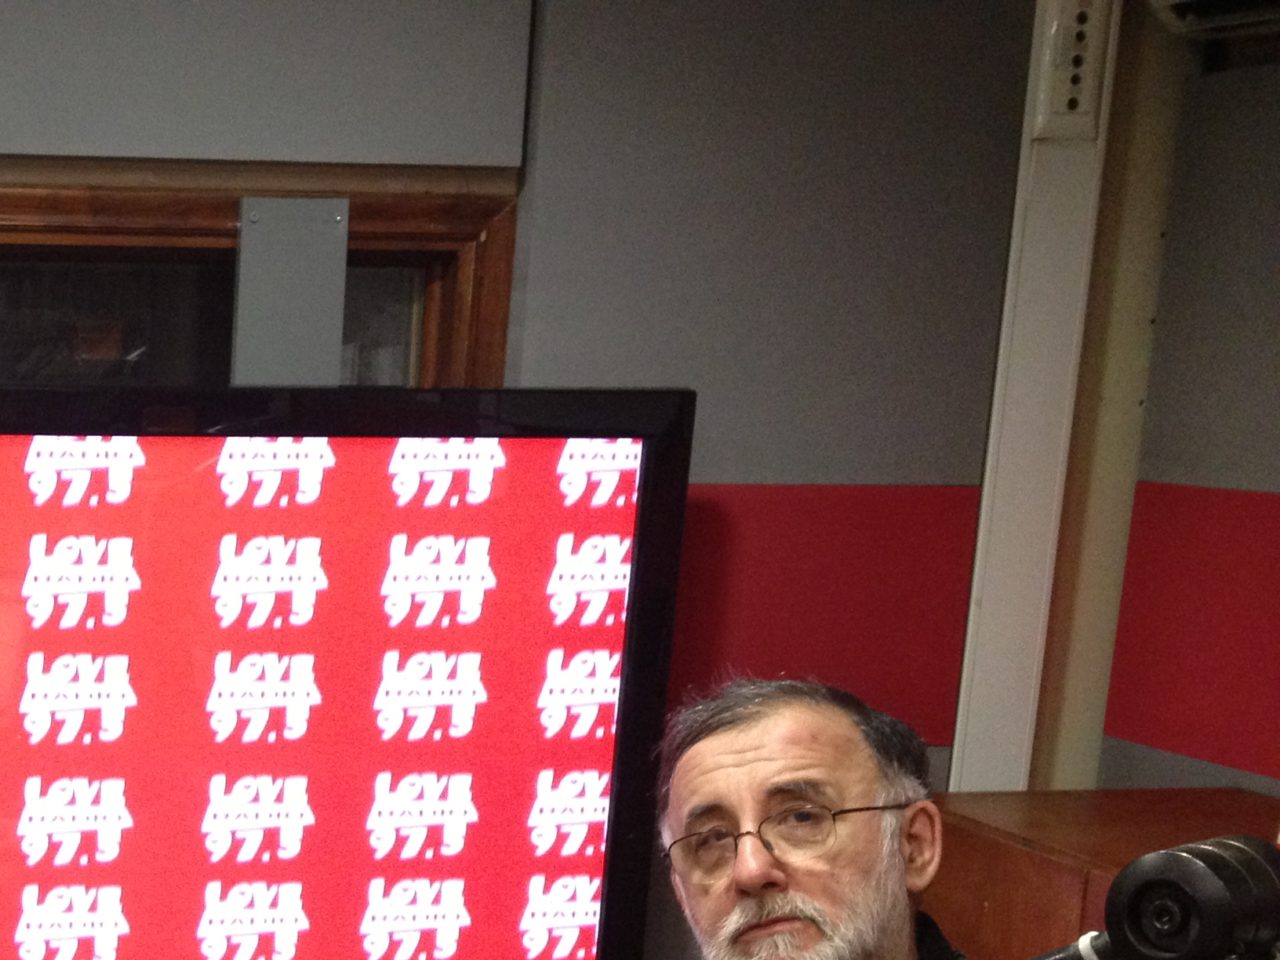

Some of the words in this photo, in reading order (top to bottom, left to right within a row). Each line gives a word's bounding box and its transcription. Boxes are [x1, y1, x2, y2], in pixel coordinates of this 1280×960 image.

[560, 468, 639, 506] 97.
[29, 533, 133, 568] LOVE
[218, 533, 320, 568] LOVE
[388, 533, 488, 567] LOVE
[554, 533, 630, 567] LOV
[550, 588, 628, 626] 97.
[26, 651, 129, 685] LOVE
[213, 650, 313, 684] LOVE
[381, 650, 479, 683] LOVE
[544, 648, 619, 681] LOV
[540, 702, 617, 738] 97.
[24, 775, 125, 808] LOVE
[208, 773, 307, 806] LOVE
[373, 771, 470, 803] LOVE
[535, 769, 608, 801] LOV
[531, 821, 606, 856] 97.
[22, 884, 121, 916] LOVE
[204, 880, 301, 912] LOVE
[367, 877, 463, 909] LOVE
[527, 874, 599, 905] LOV
[523, 925, 597, 959] 97.
